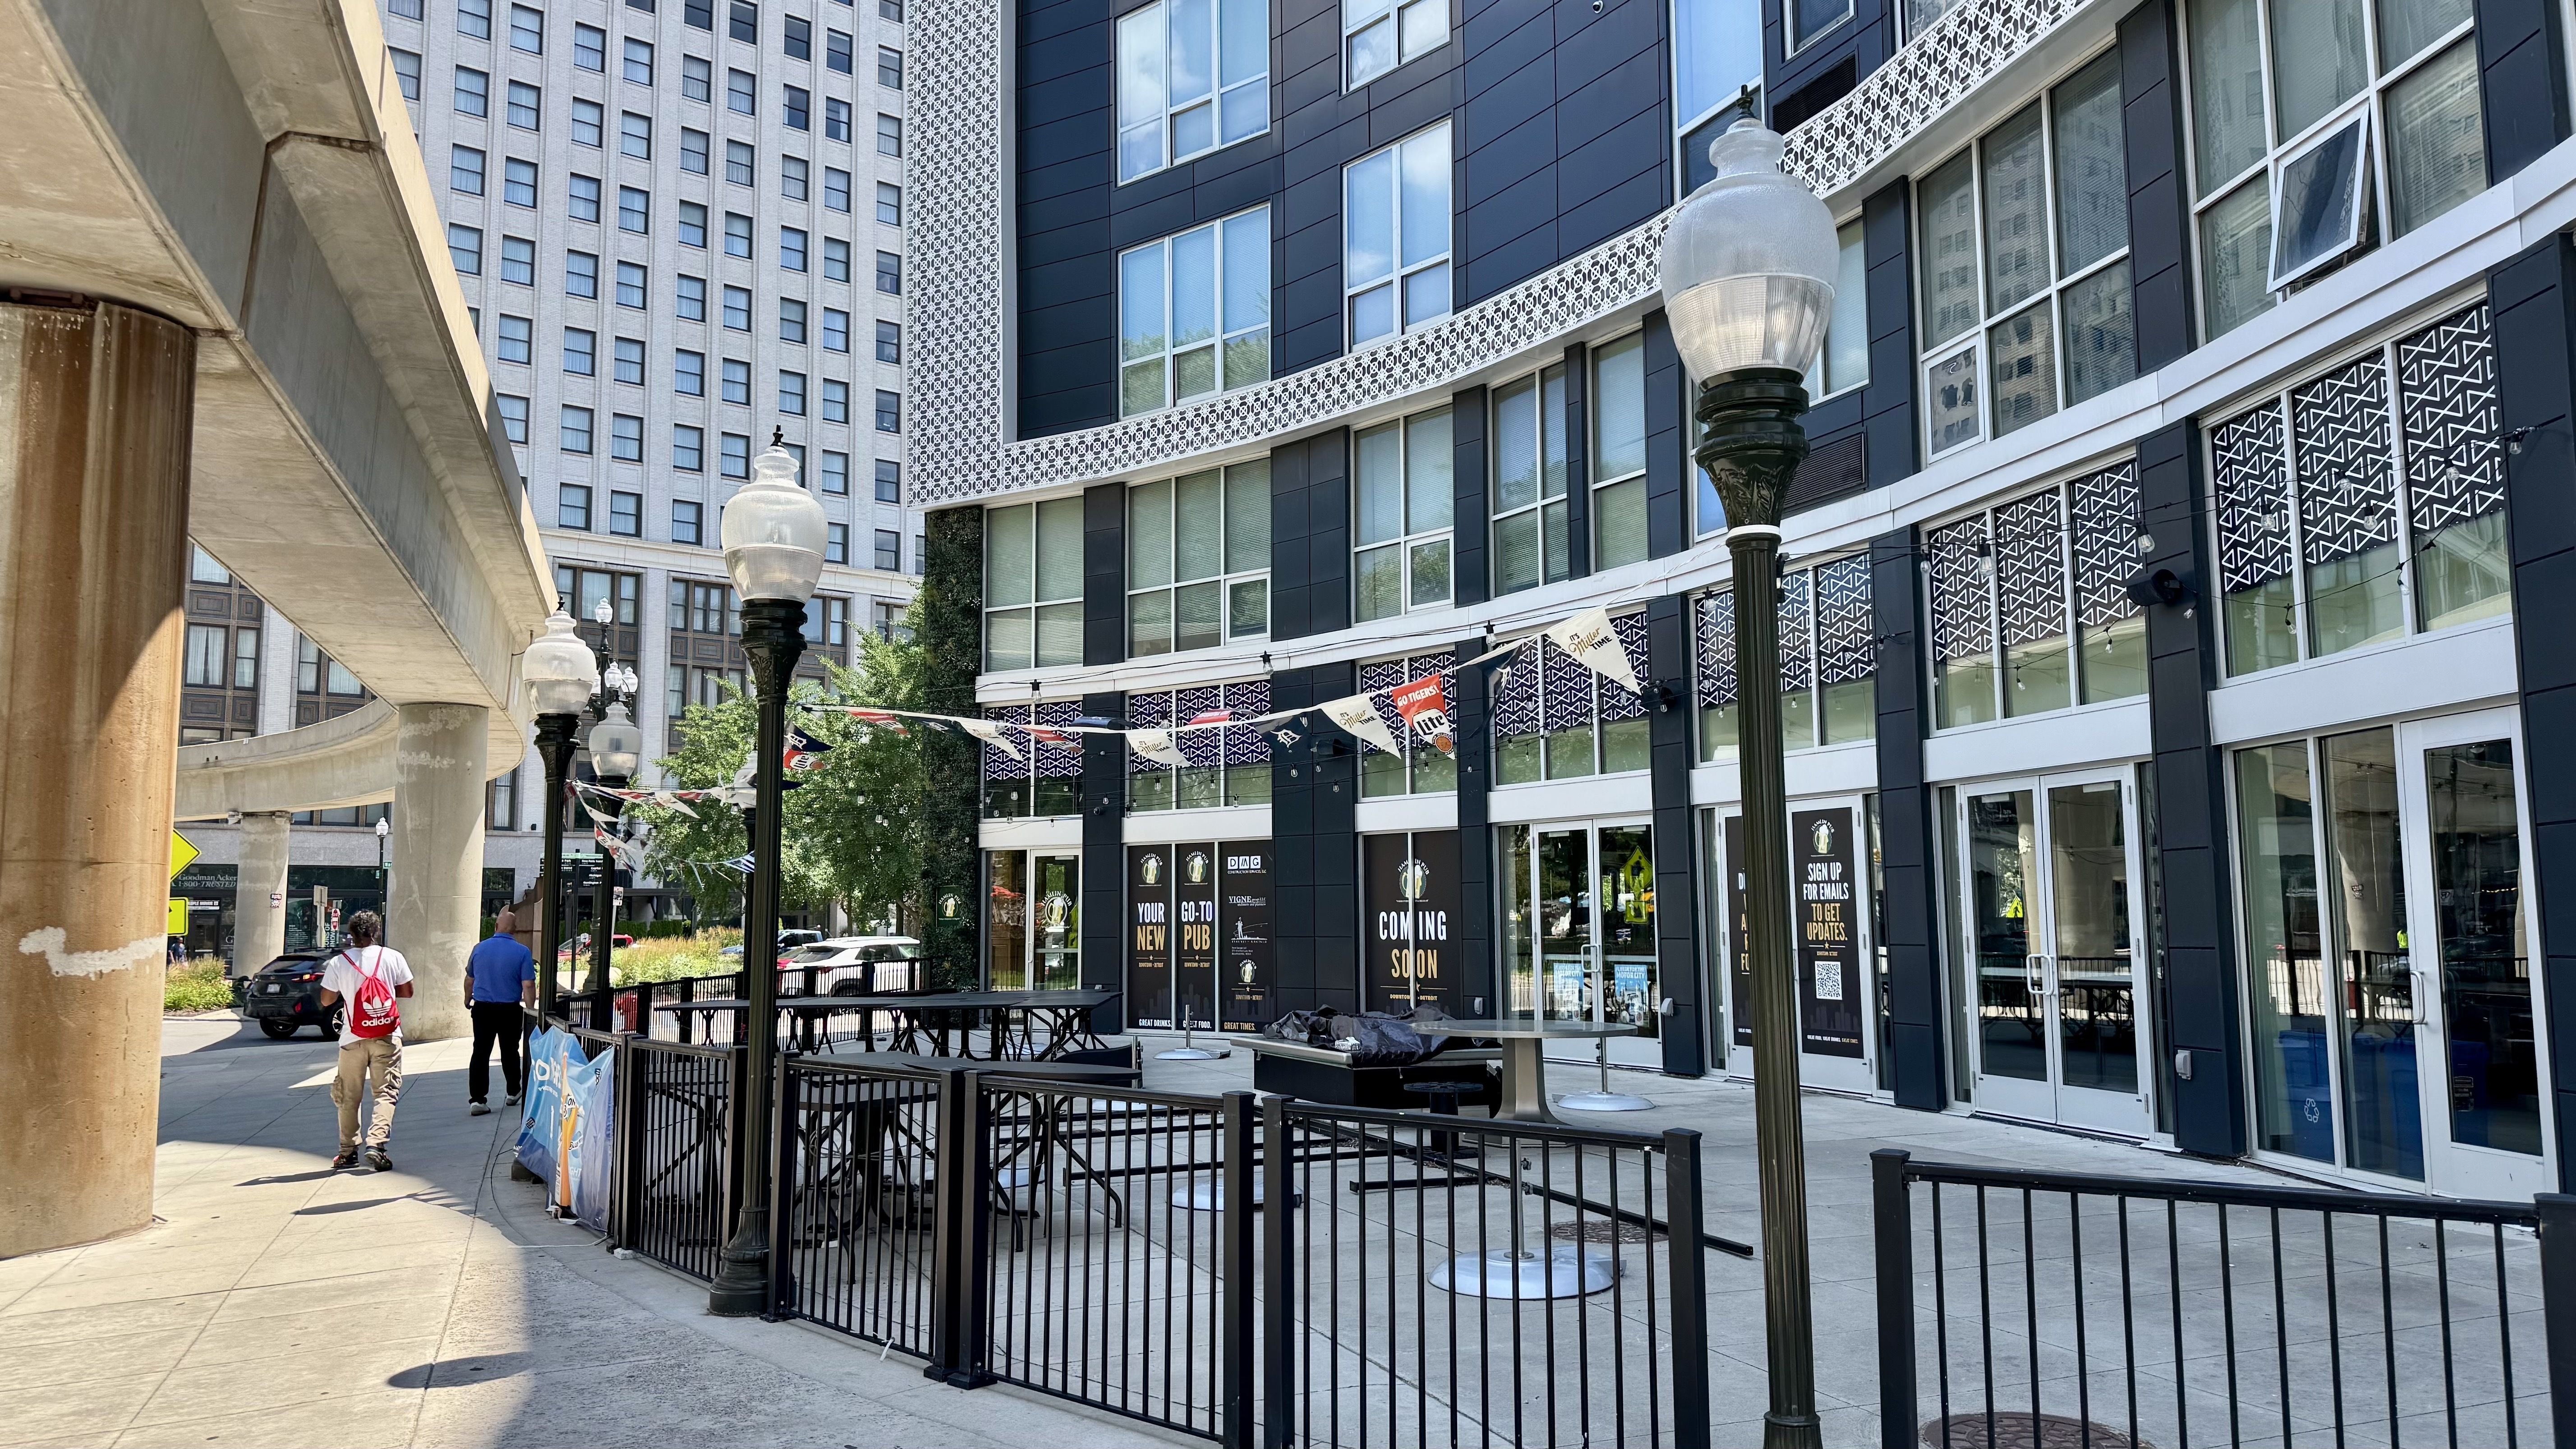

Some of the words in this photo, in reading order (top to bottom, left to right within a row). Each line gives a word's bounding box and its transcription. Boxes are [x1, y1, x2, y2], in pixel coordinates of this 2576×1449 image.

[1569, 627, 1600, 657] Miller
[1590, 635, 1612, 650] TIME
[1397, 695, 1408, 707] GO
[1408, 685, 1440, 703] TIGERS!
[1339, 710, 1366, 728] Miller
[1359, 716, 1377, 725] TIME
[1416, 715, 1445, 736] Lite
[1138, 742, 1162, 754] Miller
[1421, 862, 1430, 875] PUB
[1808, 863, 1828, 881] SIGN
[1830, 862, 1842, 880] UP
[1803, 883, 1818, 900] FOR
[1819, 882, 1849, 900] EMAILS
[1137, 902, 1165, 923] YOUR
[1181, 901, 1213, 922] GO-TO
[1811, 903, 1822, 921] TO
[1825, 903, 1840, 921] GET
[1379, 911, 1447, 940] COMING
[1807, 922, 1848, 941] UPDATES.
[1137, 925, 1166, 950] NEW
[1184, 925, 1210, 950] PUB
[1391, 949, 1437, 979] SOON
[1154, 1019, 1172, 1027] DRINKS.
[1198, 1021, 1212, 1029] FOOD.
[1239, 1022, 1256, 1030] TIMES.
